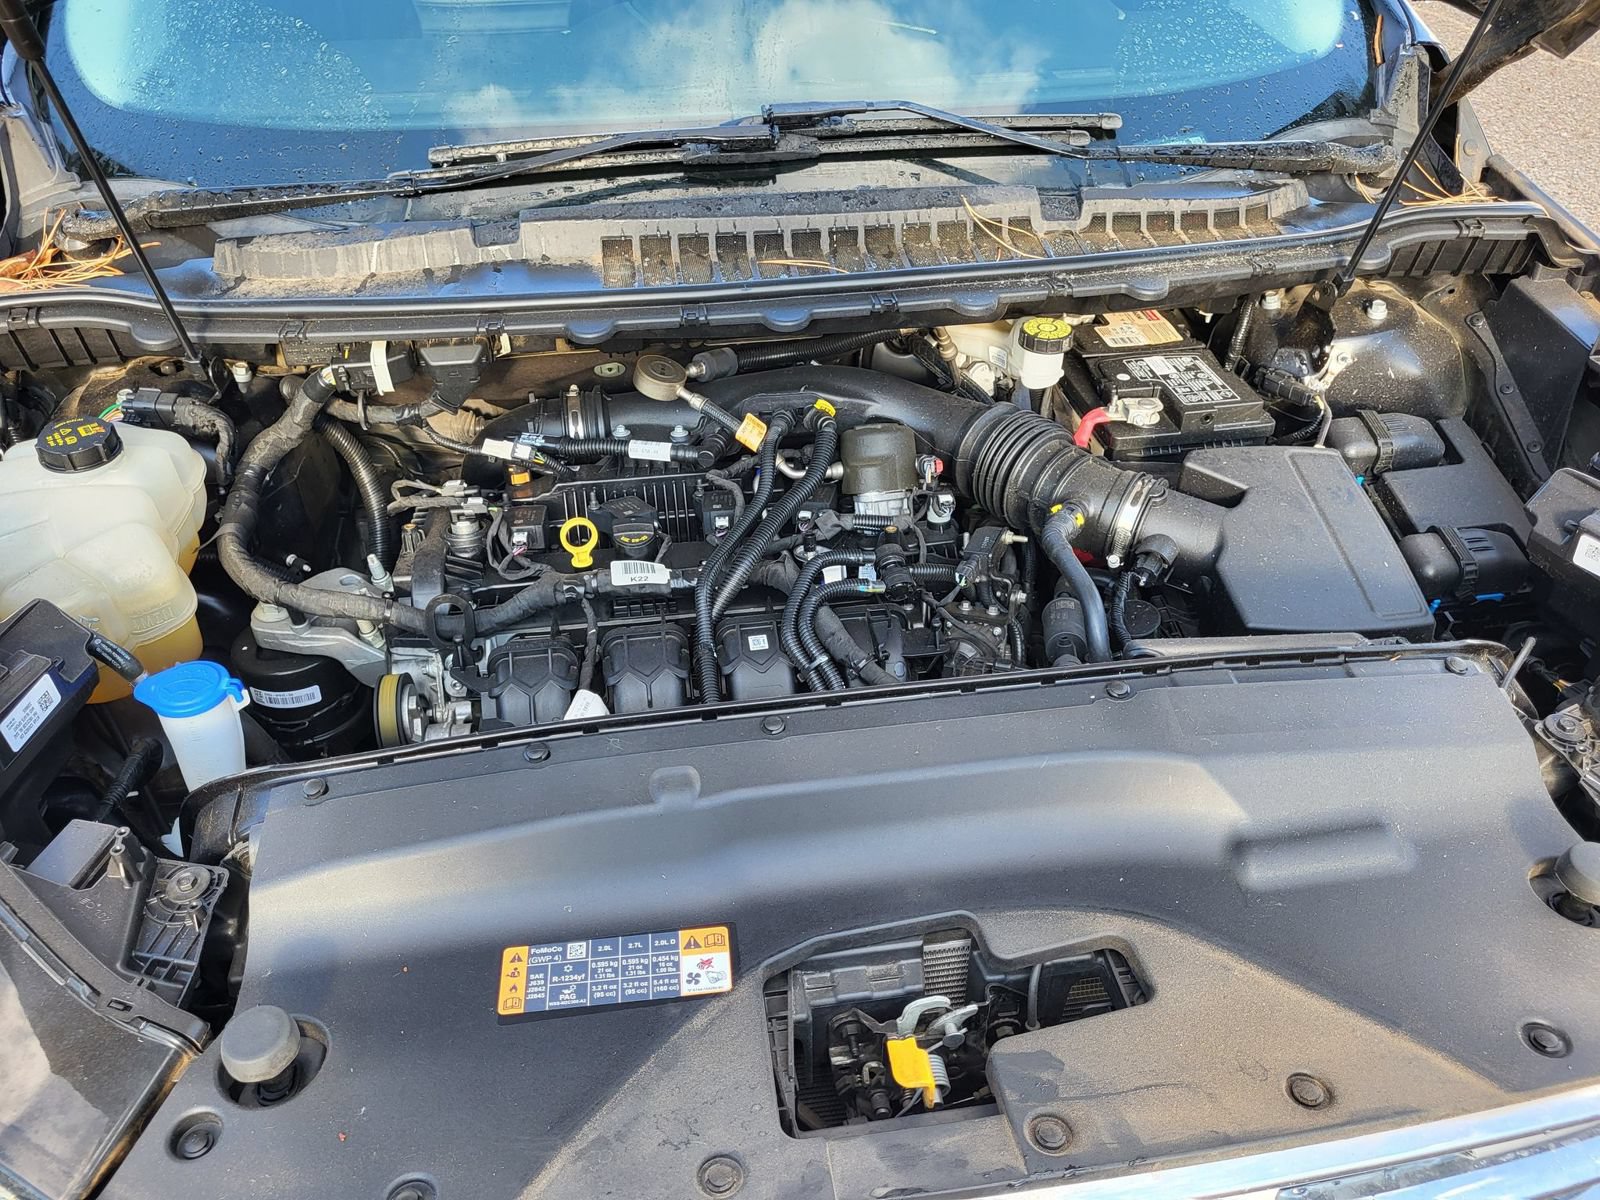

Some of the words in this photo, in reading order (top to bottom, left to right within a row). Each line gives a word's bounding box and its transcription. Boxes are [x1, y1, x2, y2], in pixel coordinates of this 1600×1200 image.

[530, 946, 563, 954] FoMoCo
[528, 955, 552, 966] (GWP
[553, 954, 562, 962] 4)
[552, 973, 585, 982] R-1234yf
